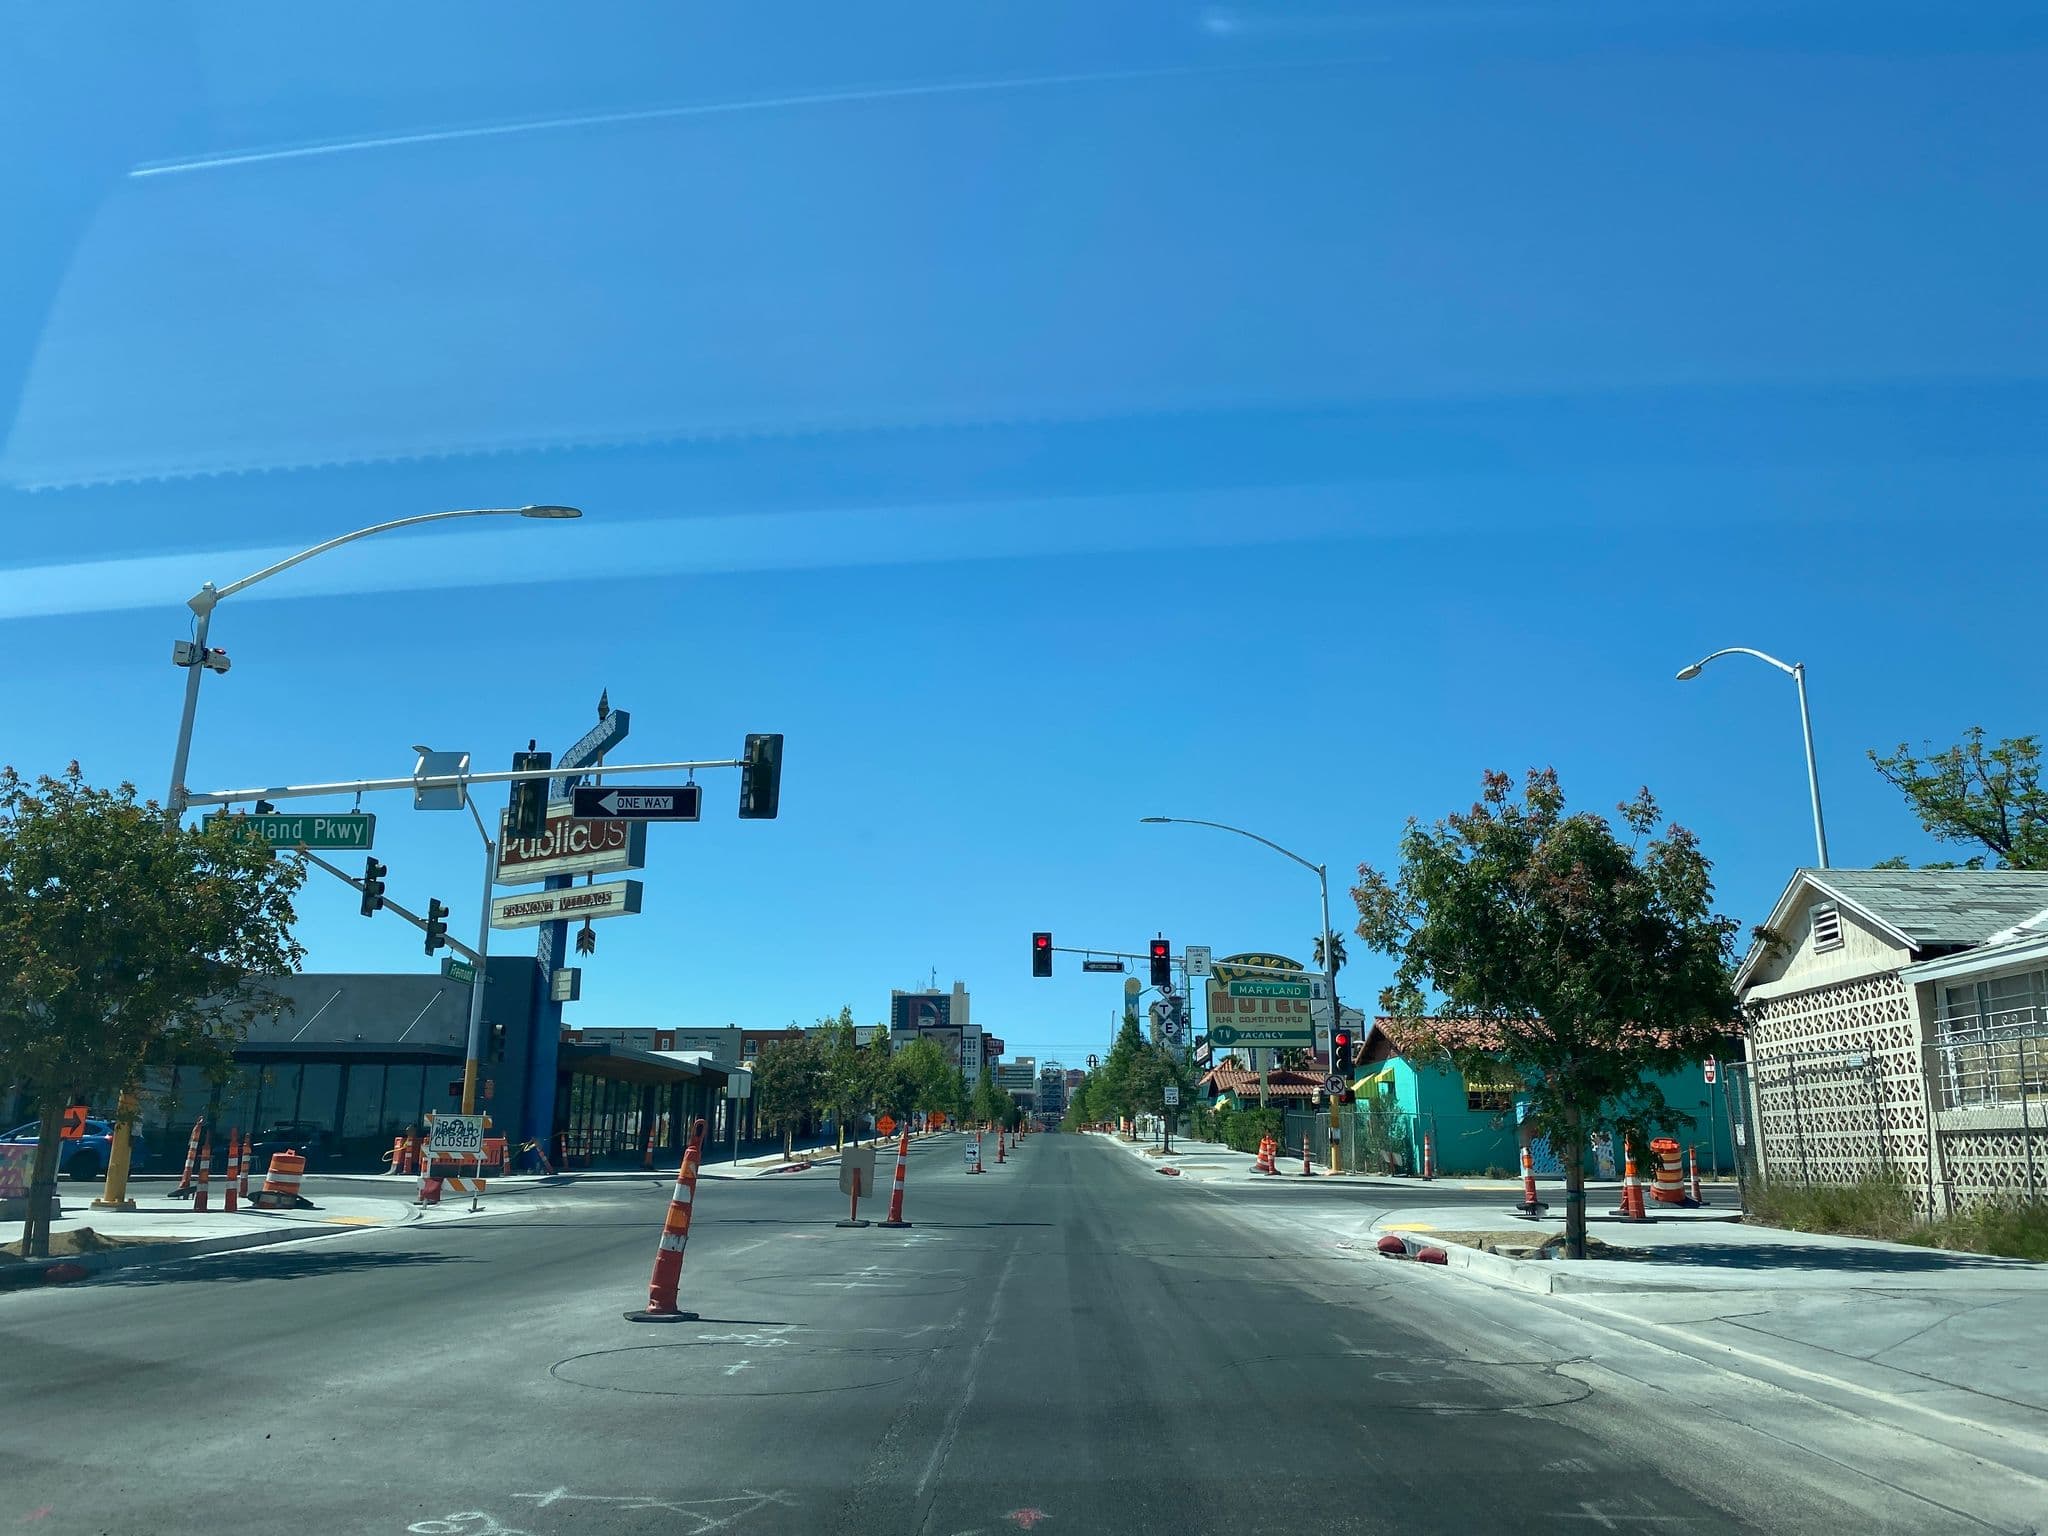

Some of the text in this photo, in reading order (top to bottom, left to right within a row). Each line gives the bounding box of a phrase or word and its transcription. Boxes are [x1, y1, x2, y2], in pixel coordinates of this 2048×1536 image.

[617, 797, 670, 809] ONE WAY
[315, 818, 364, 844] Pkwy
[503, 891, 612, 918] FREMONT VILLAGE
[1239, 984, 1302, 996] MARYLAND
[1219, 1030, 1231, 1039] TV
[1239, 1031, 1285, 1039] VACANCY
[434, 1137, 477, 1148] CLOSED
